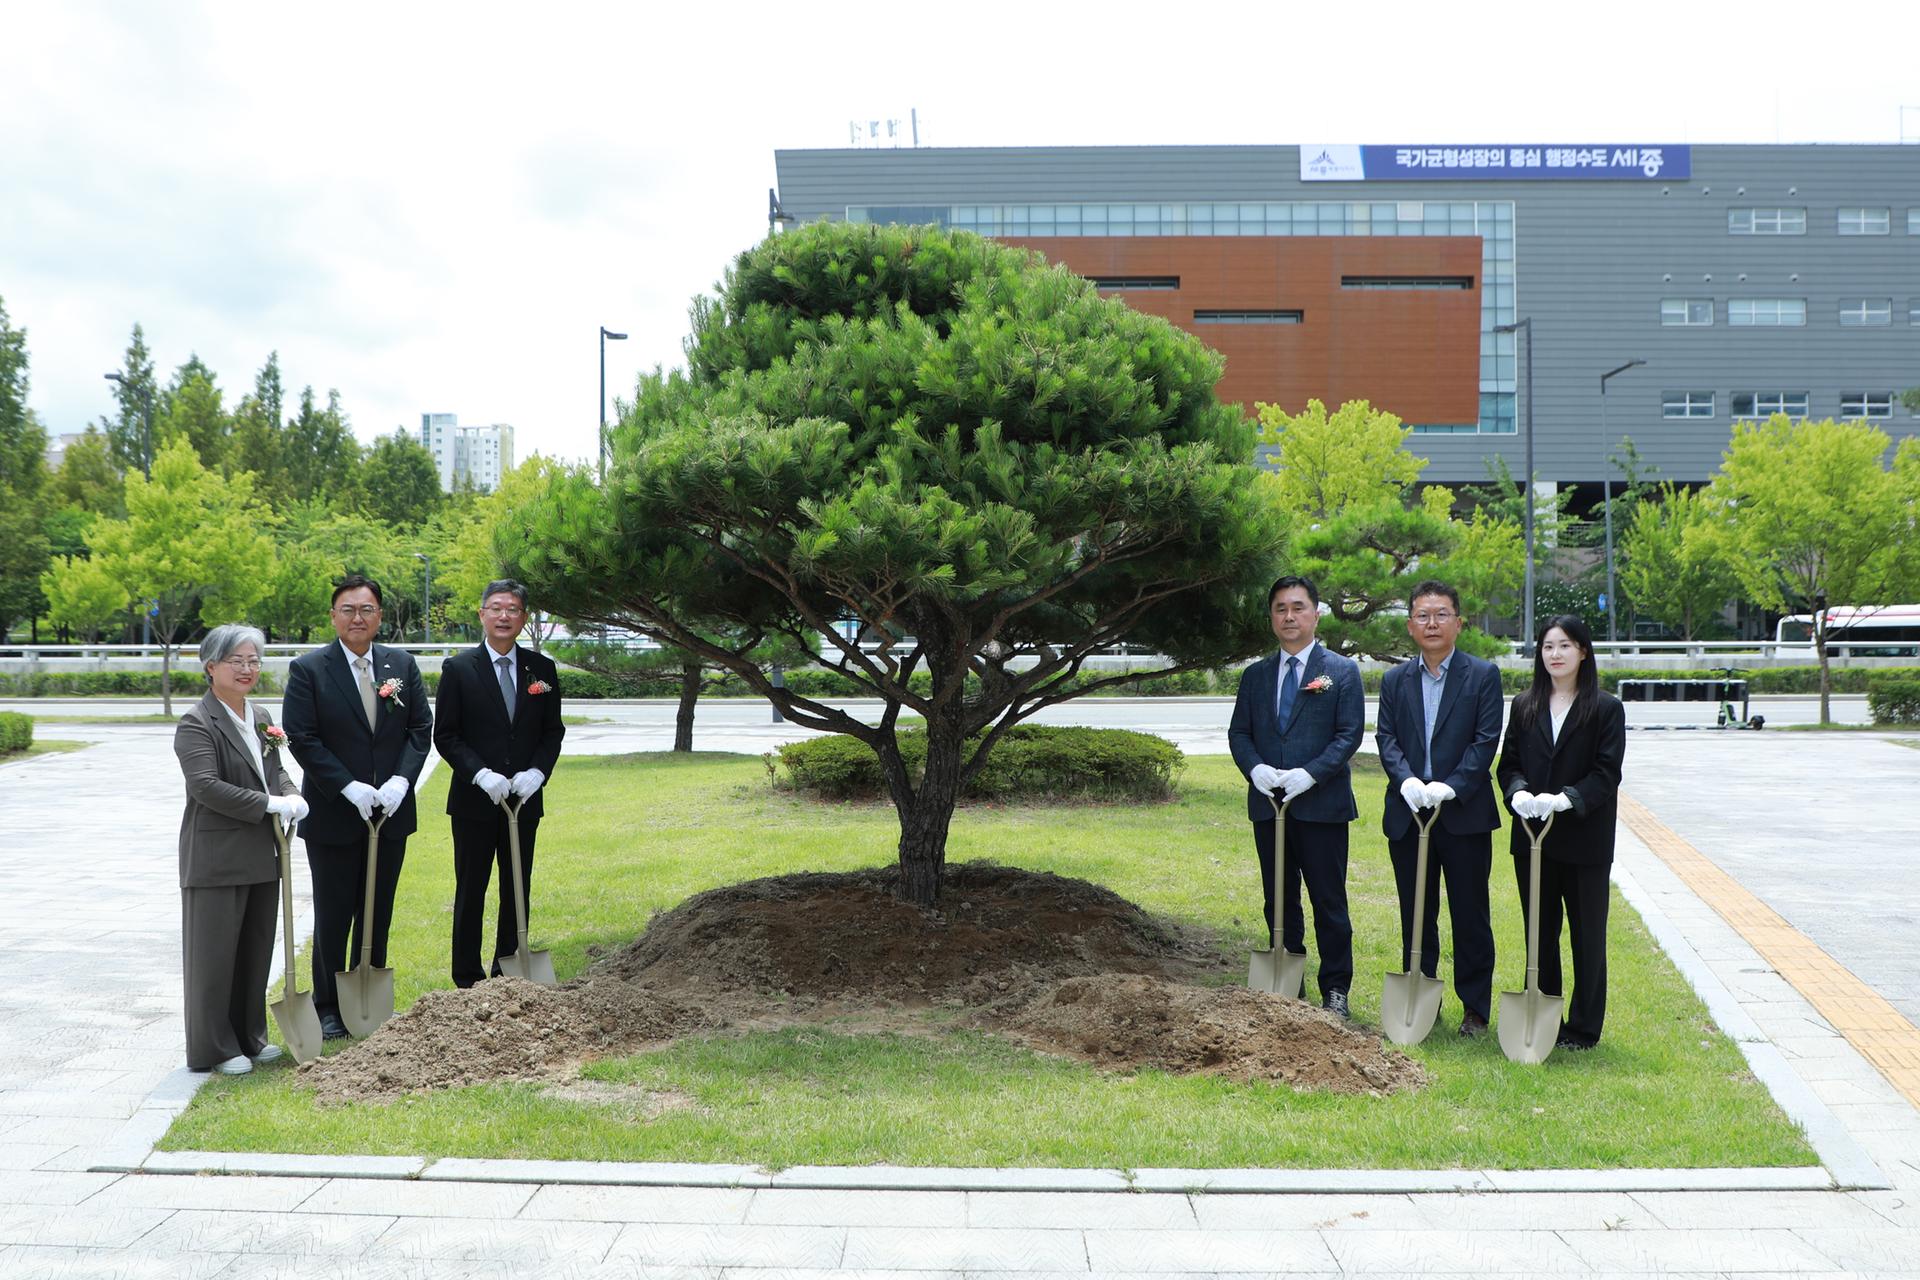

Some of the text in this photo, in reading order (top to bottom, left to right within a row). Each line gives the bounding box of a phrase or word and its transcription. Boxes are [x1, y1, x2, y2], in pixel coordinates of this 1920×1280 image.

[1396, 148, 1664, 178] 국가균형성장의 중심 행정수도 세종
